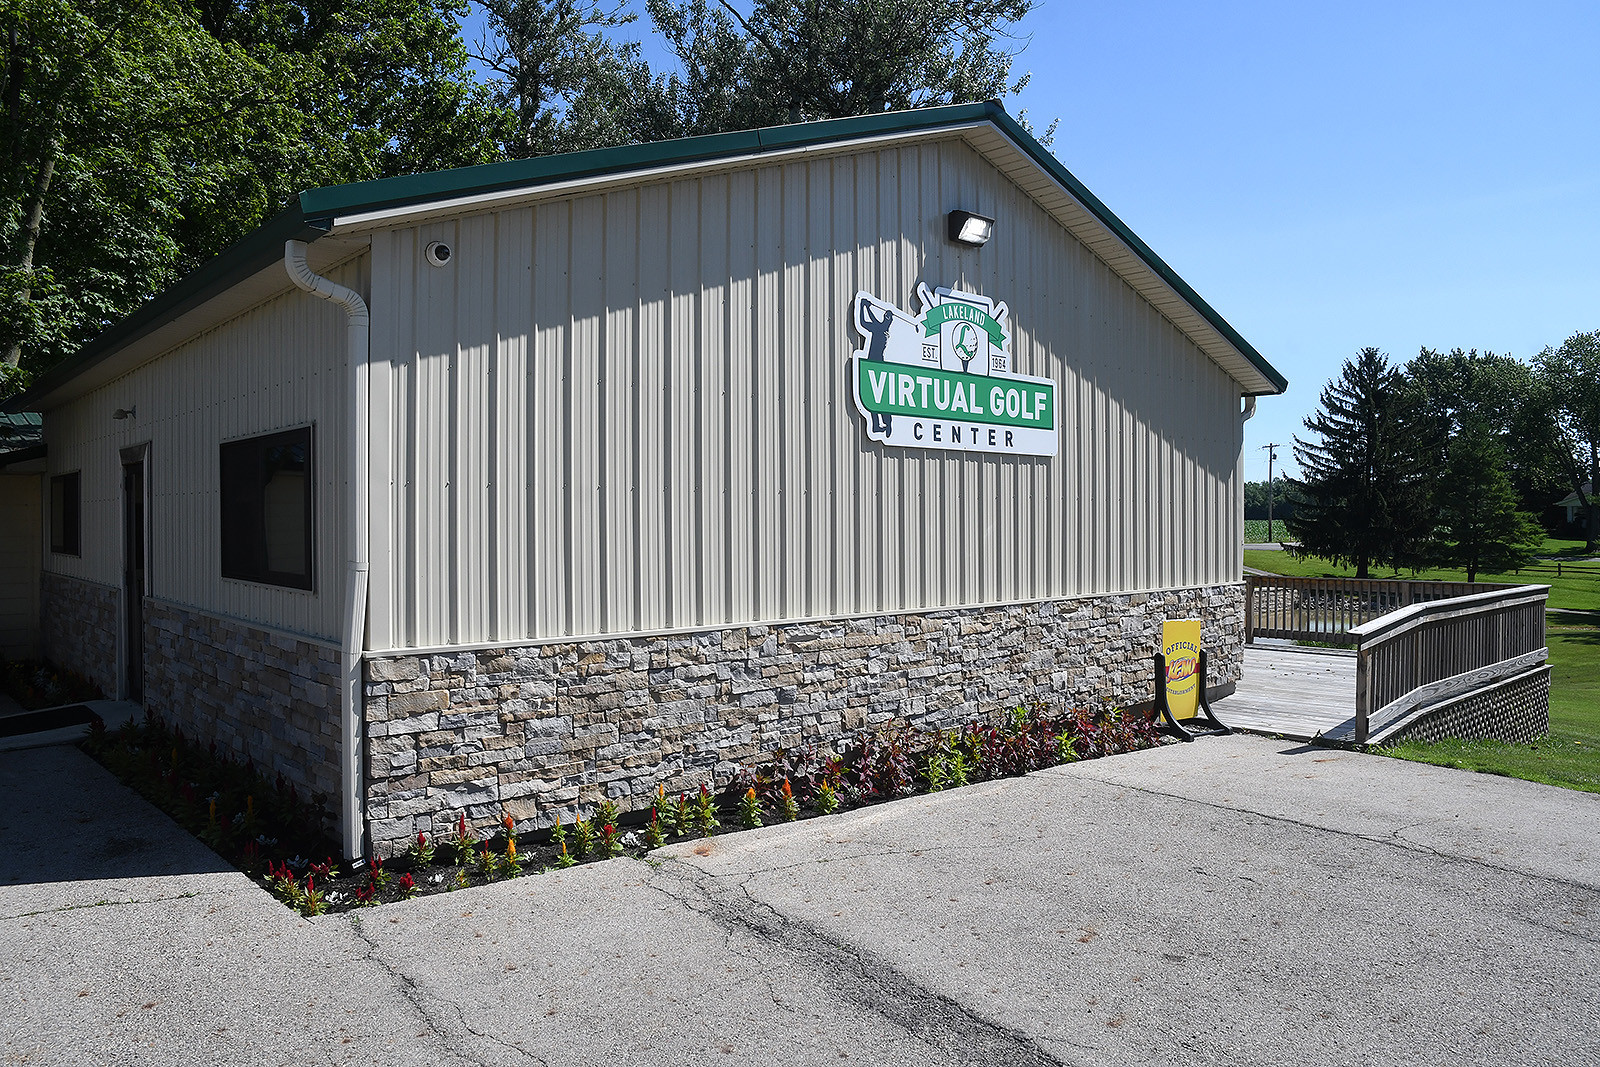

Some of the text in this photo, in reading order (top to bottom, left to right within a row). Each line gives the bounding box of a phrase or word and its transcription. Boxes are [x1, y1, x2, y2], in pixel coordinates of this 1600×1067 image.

[942, 306, 985, 326] LAKELAND
[922, 346, 938, 359] EST.
[992, 357, 1006, 369] 1964
[867, 370, 1047, 421] VIRTUAL GOLF
[913, 422, 1014, 447] CENTER
[1165, 641, 1198, 656] OFFICIAL
[1167, 657, 1196, 684] KENO
